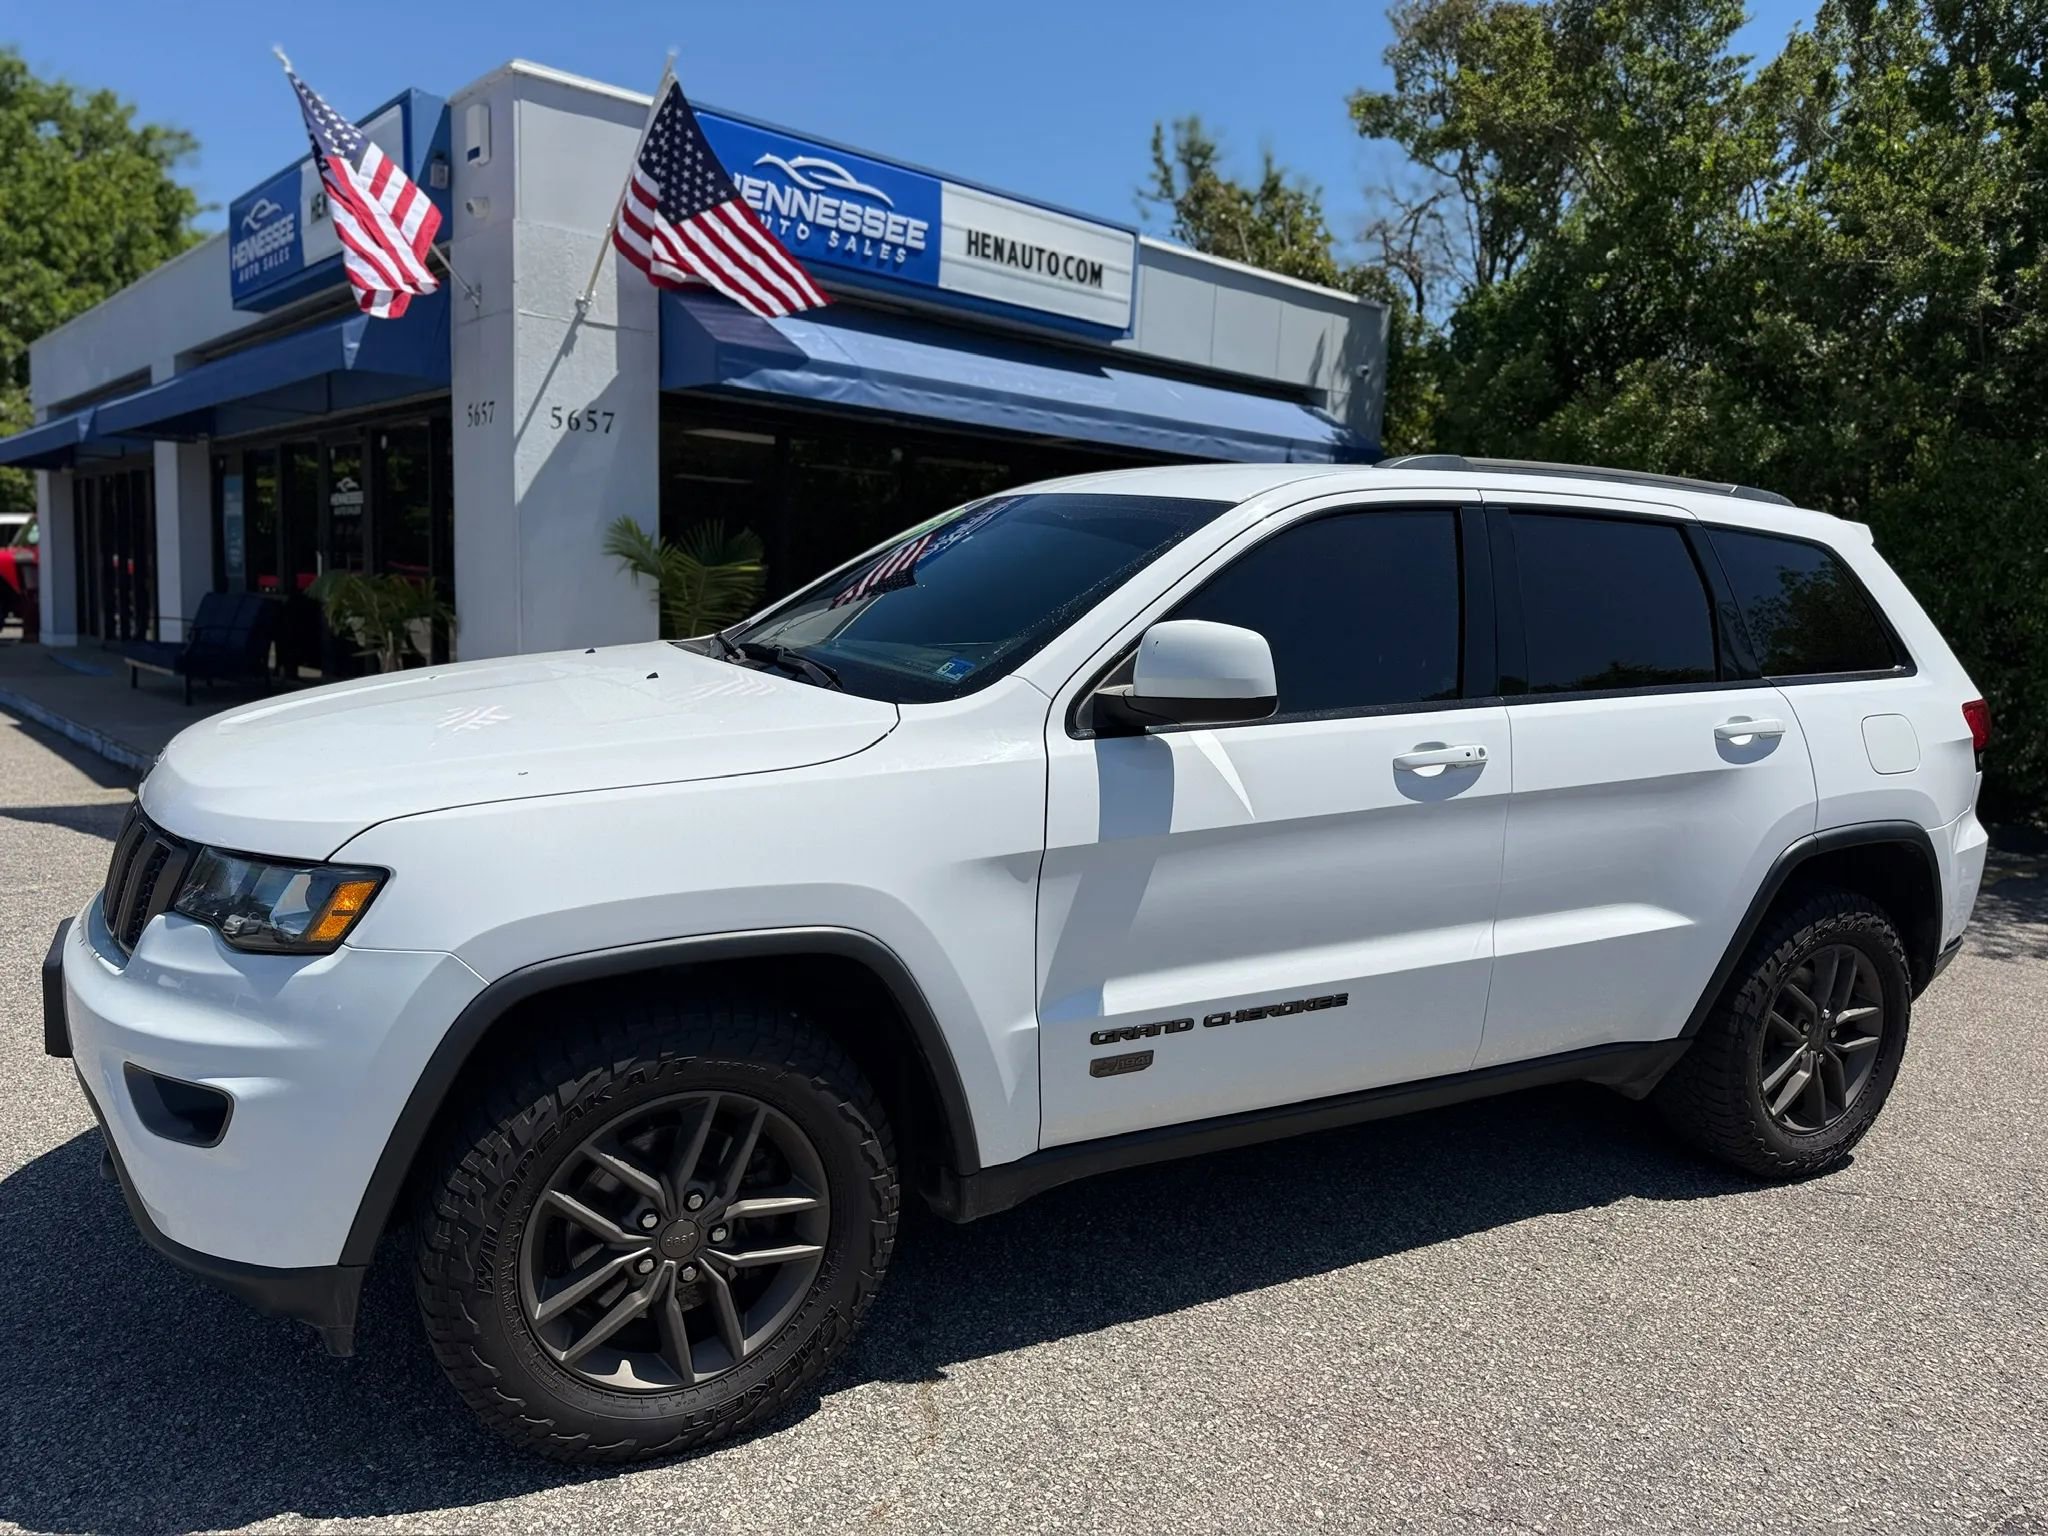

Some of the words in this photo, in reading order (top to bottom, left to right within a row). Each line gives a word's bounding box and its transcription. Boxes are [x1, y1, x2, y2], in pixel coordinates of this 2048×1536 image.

[232, 212, 295, 271] HENNESSEE
[828, 230, 908, 263] SALES
[263, 246, 290, 271] SALES
[467, 401, 495, 427] 5657
[550, 407, 615, 434] 5657
[1090, 1017, 1194, 1045] GRAND
[1203, 992, 1349, 1027] CHEROKEE
